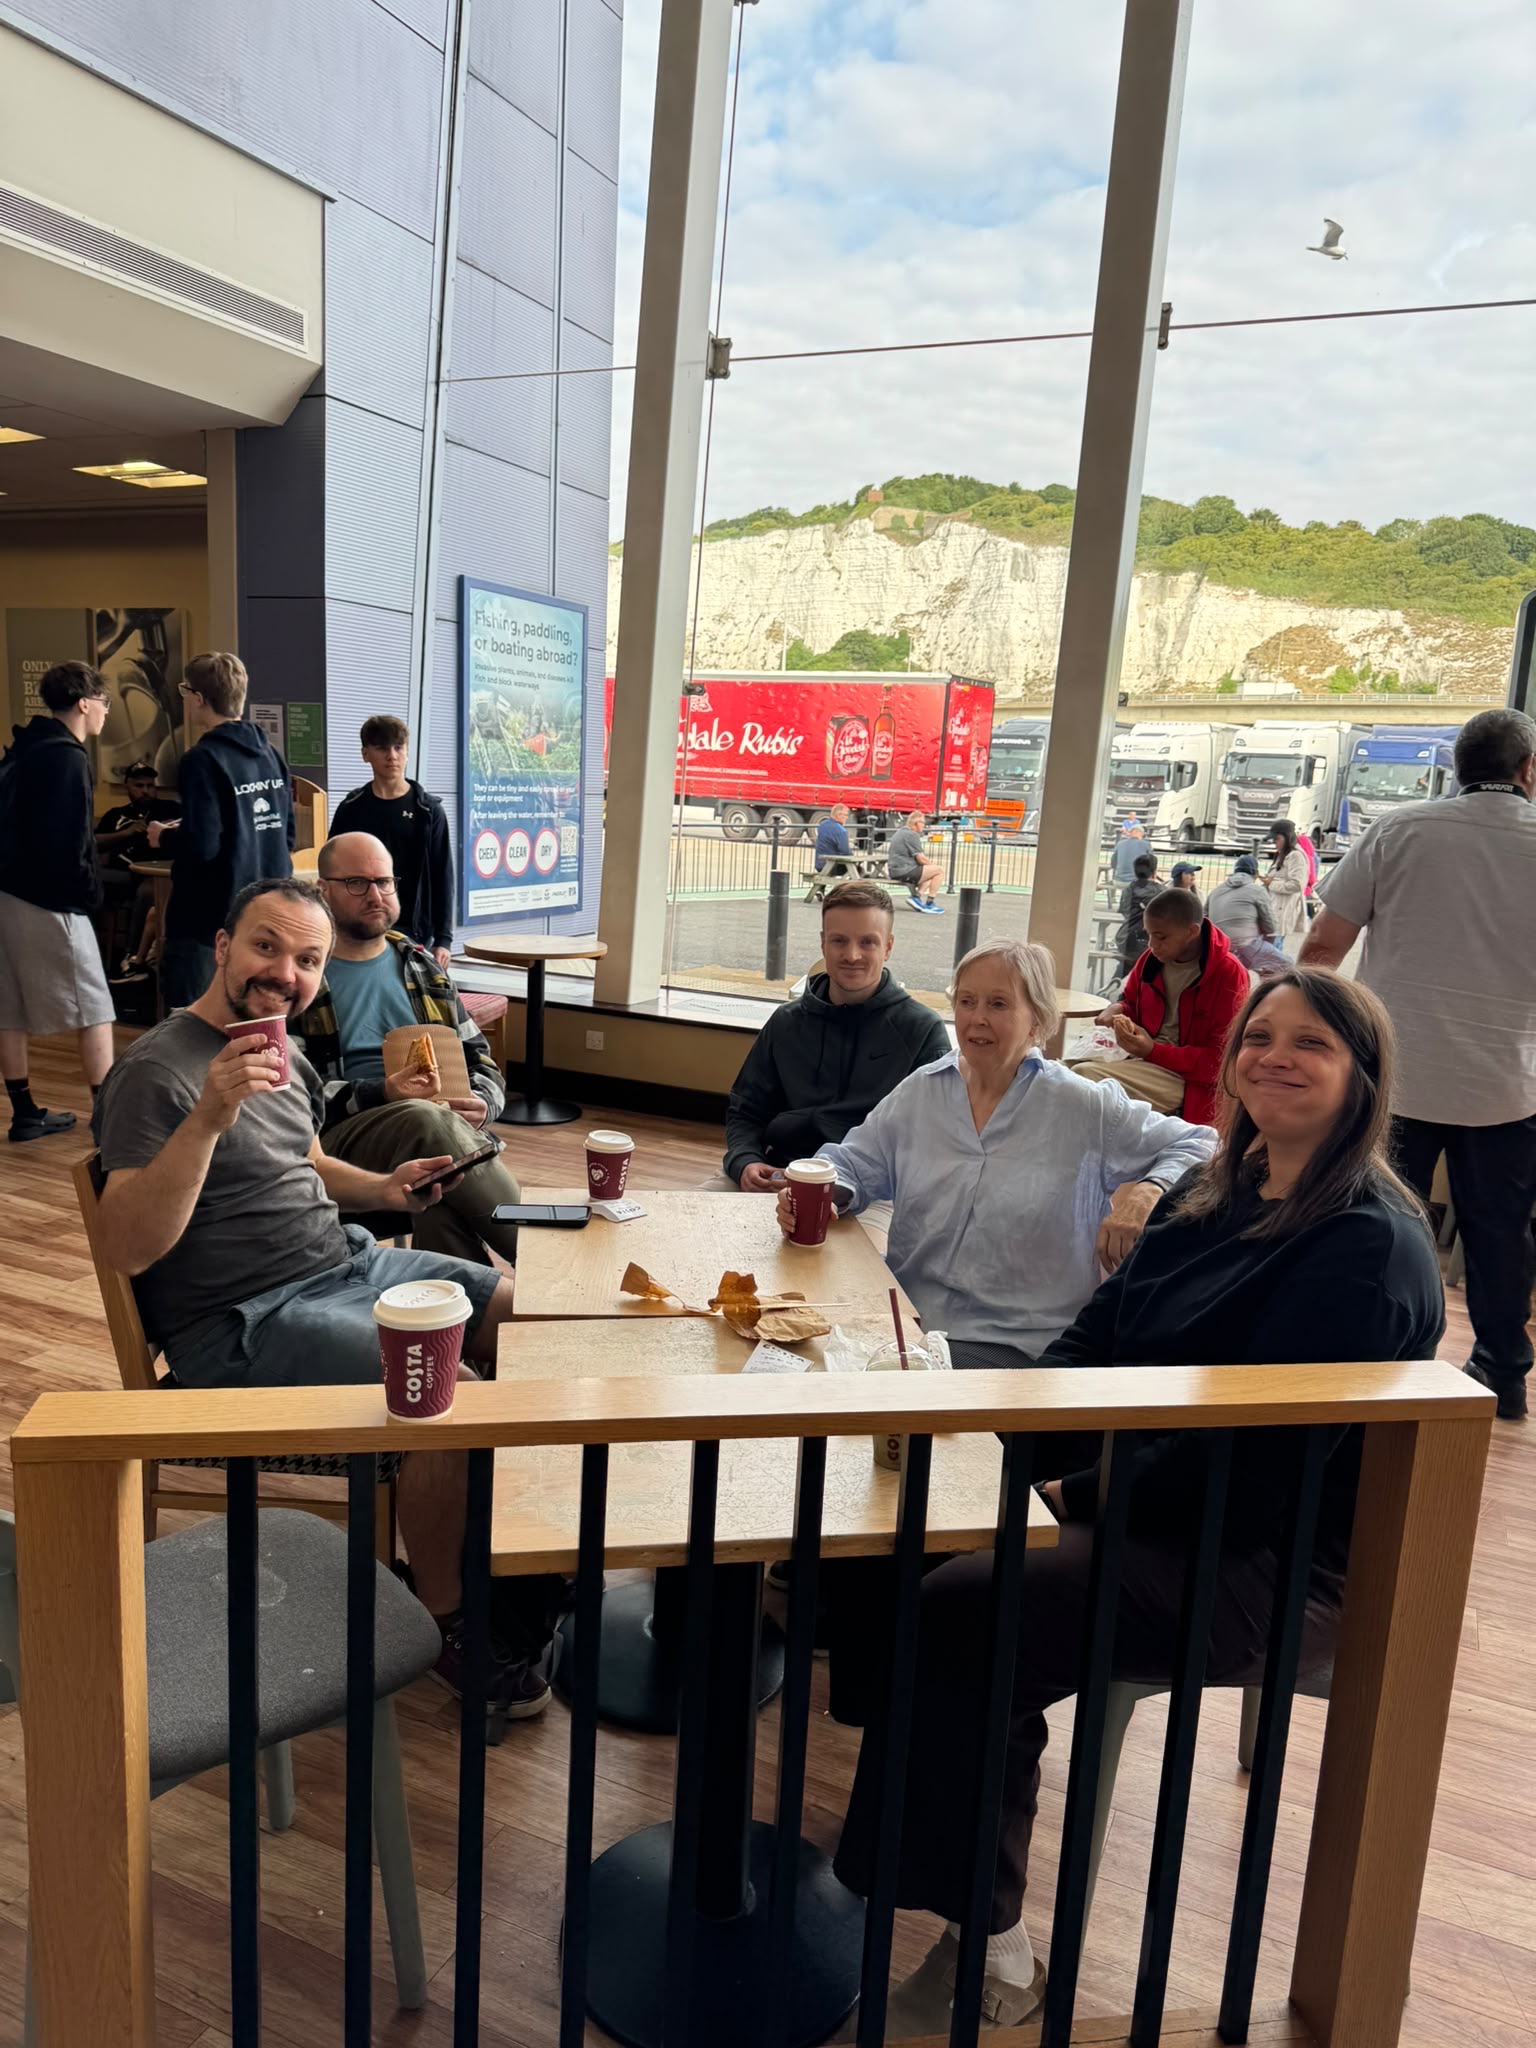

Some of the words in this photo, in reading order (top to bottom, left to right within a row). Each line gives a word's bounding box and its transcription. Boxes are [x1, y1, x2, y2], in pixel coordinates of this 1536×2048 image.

[475, 610, 521, 637] Fishing,
[523, 622, 572, 646] paddling,
[474, 638, 488, 651] or
[491, 636, 534, 662] boating
[536, 646, 578, 666] abroad?
[739, 722, 804, 755] Rubis
[474, 783, 486, 793] They
[479, 847, 498, 860] CHECK
[509, 846, 527, 858] CLEAN
[541, 845, 552, 857] DRY
[618, 1158, 629, 1191] COSTA
[406, 1343, 424, 1403] COSTA
